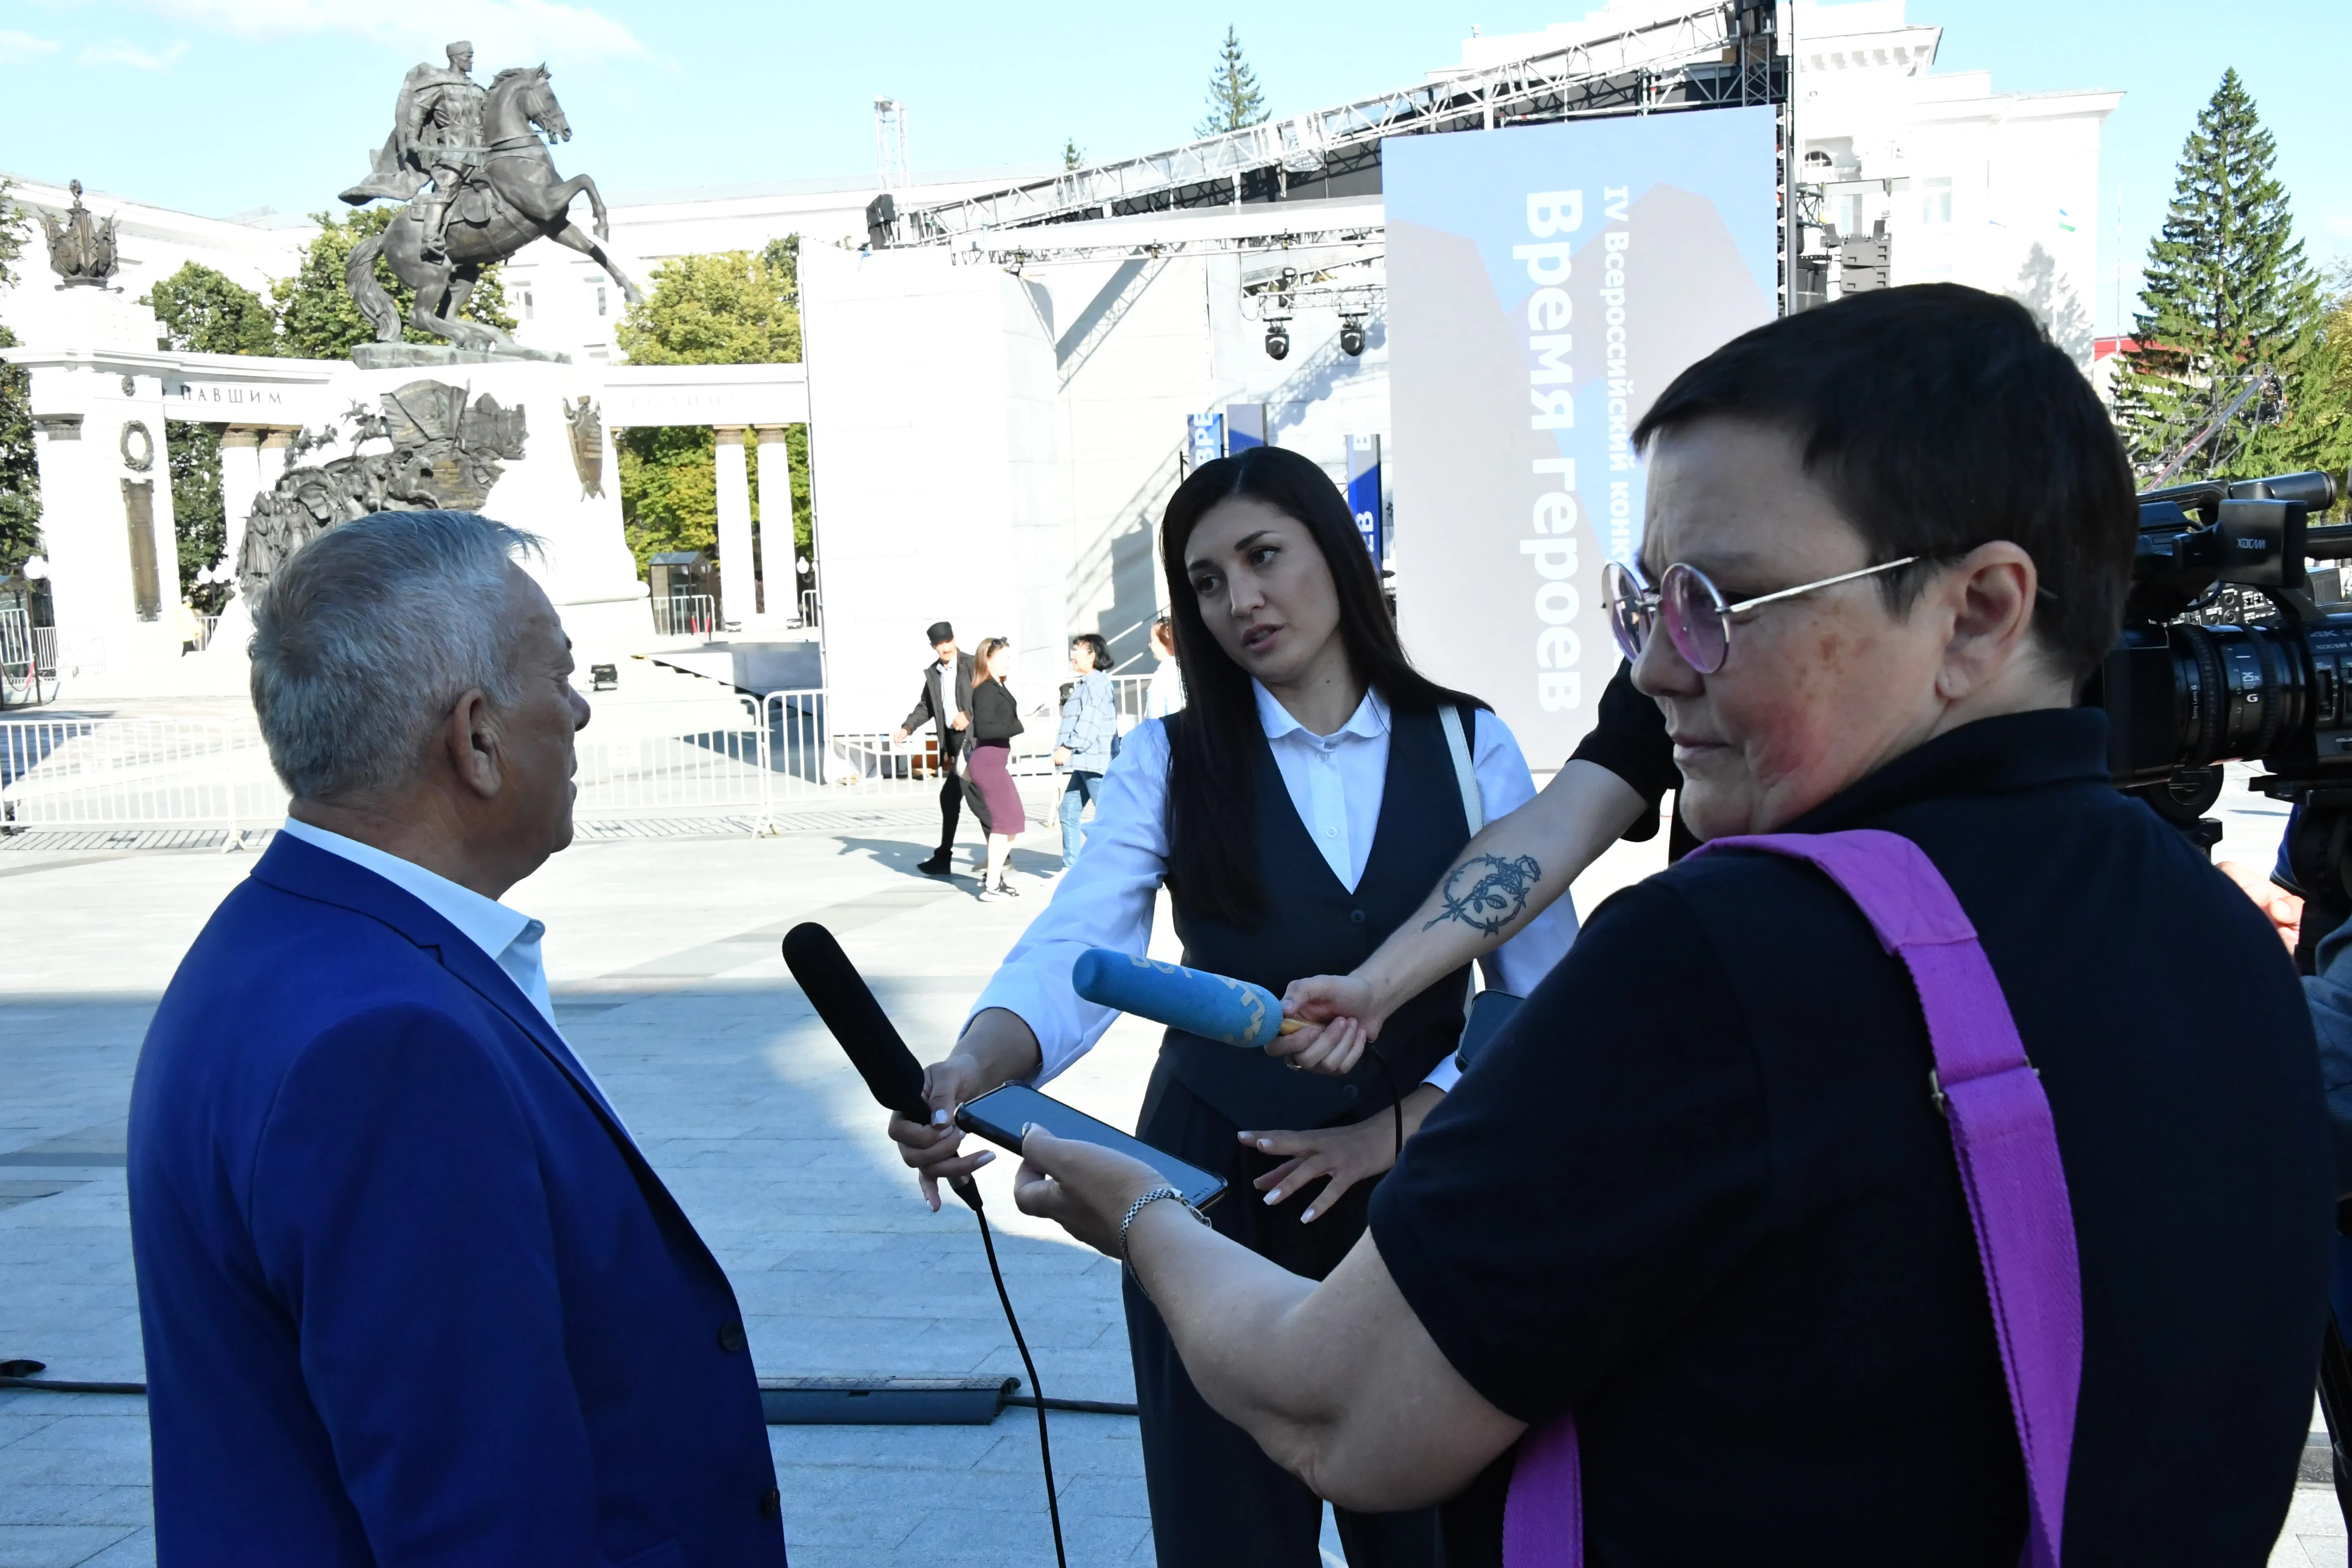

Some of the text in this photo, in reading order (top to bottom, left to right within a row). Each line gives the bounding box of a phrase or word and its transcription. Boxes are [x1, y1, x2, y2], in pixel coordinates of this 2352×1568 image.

[180, 385, 282, 404] ПАВШИМ
[1600, 231, 1635, 471] Всероссийский
[1513, 190, 1583, 713] Время героев
[2246, 694, 2258, 703] G
